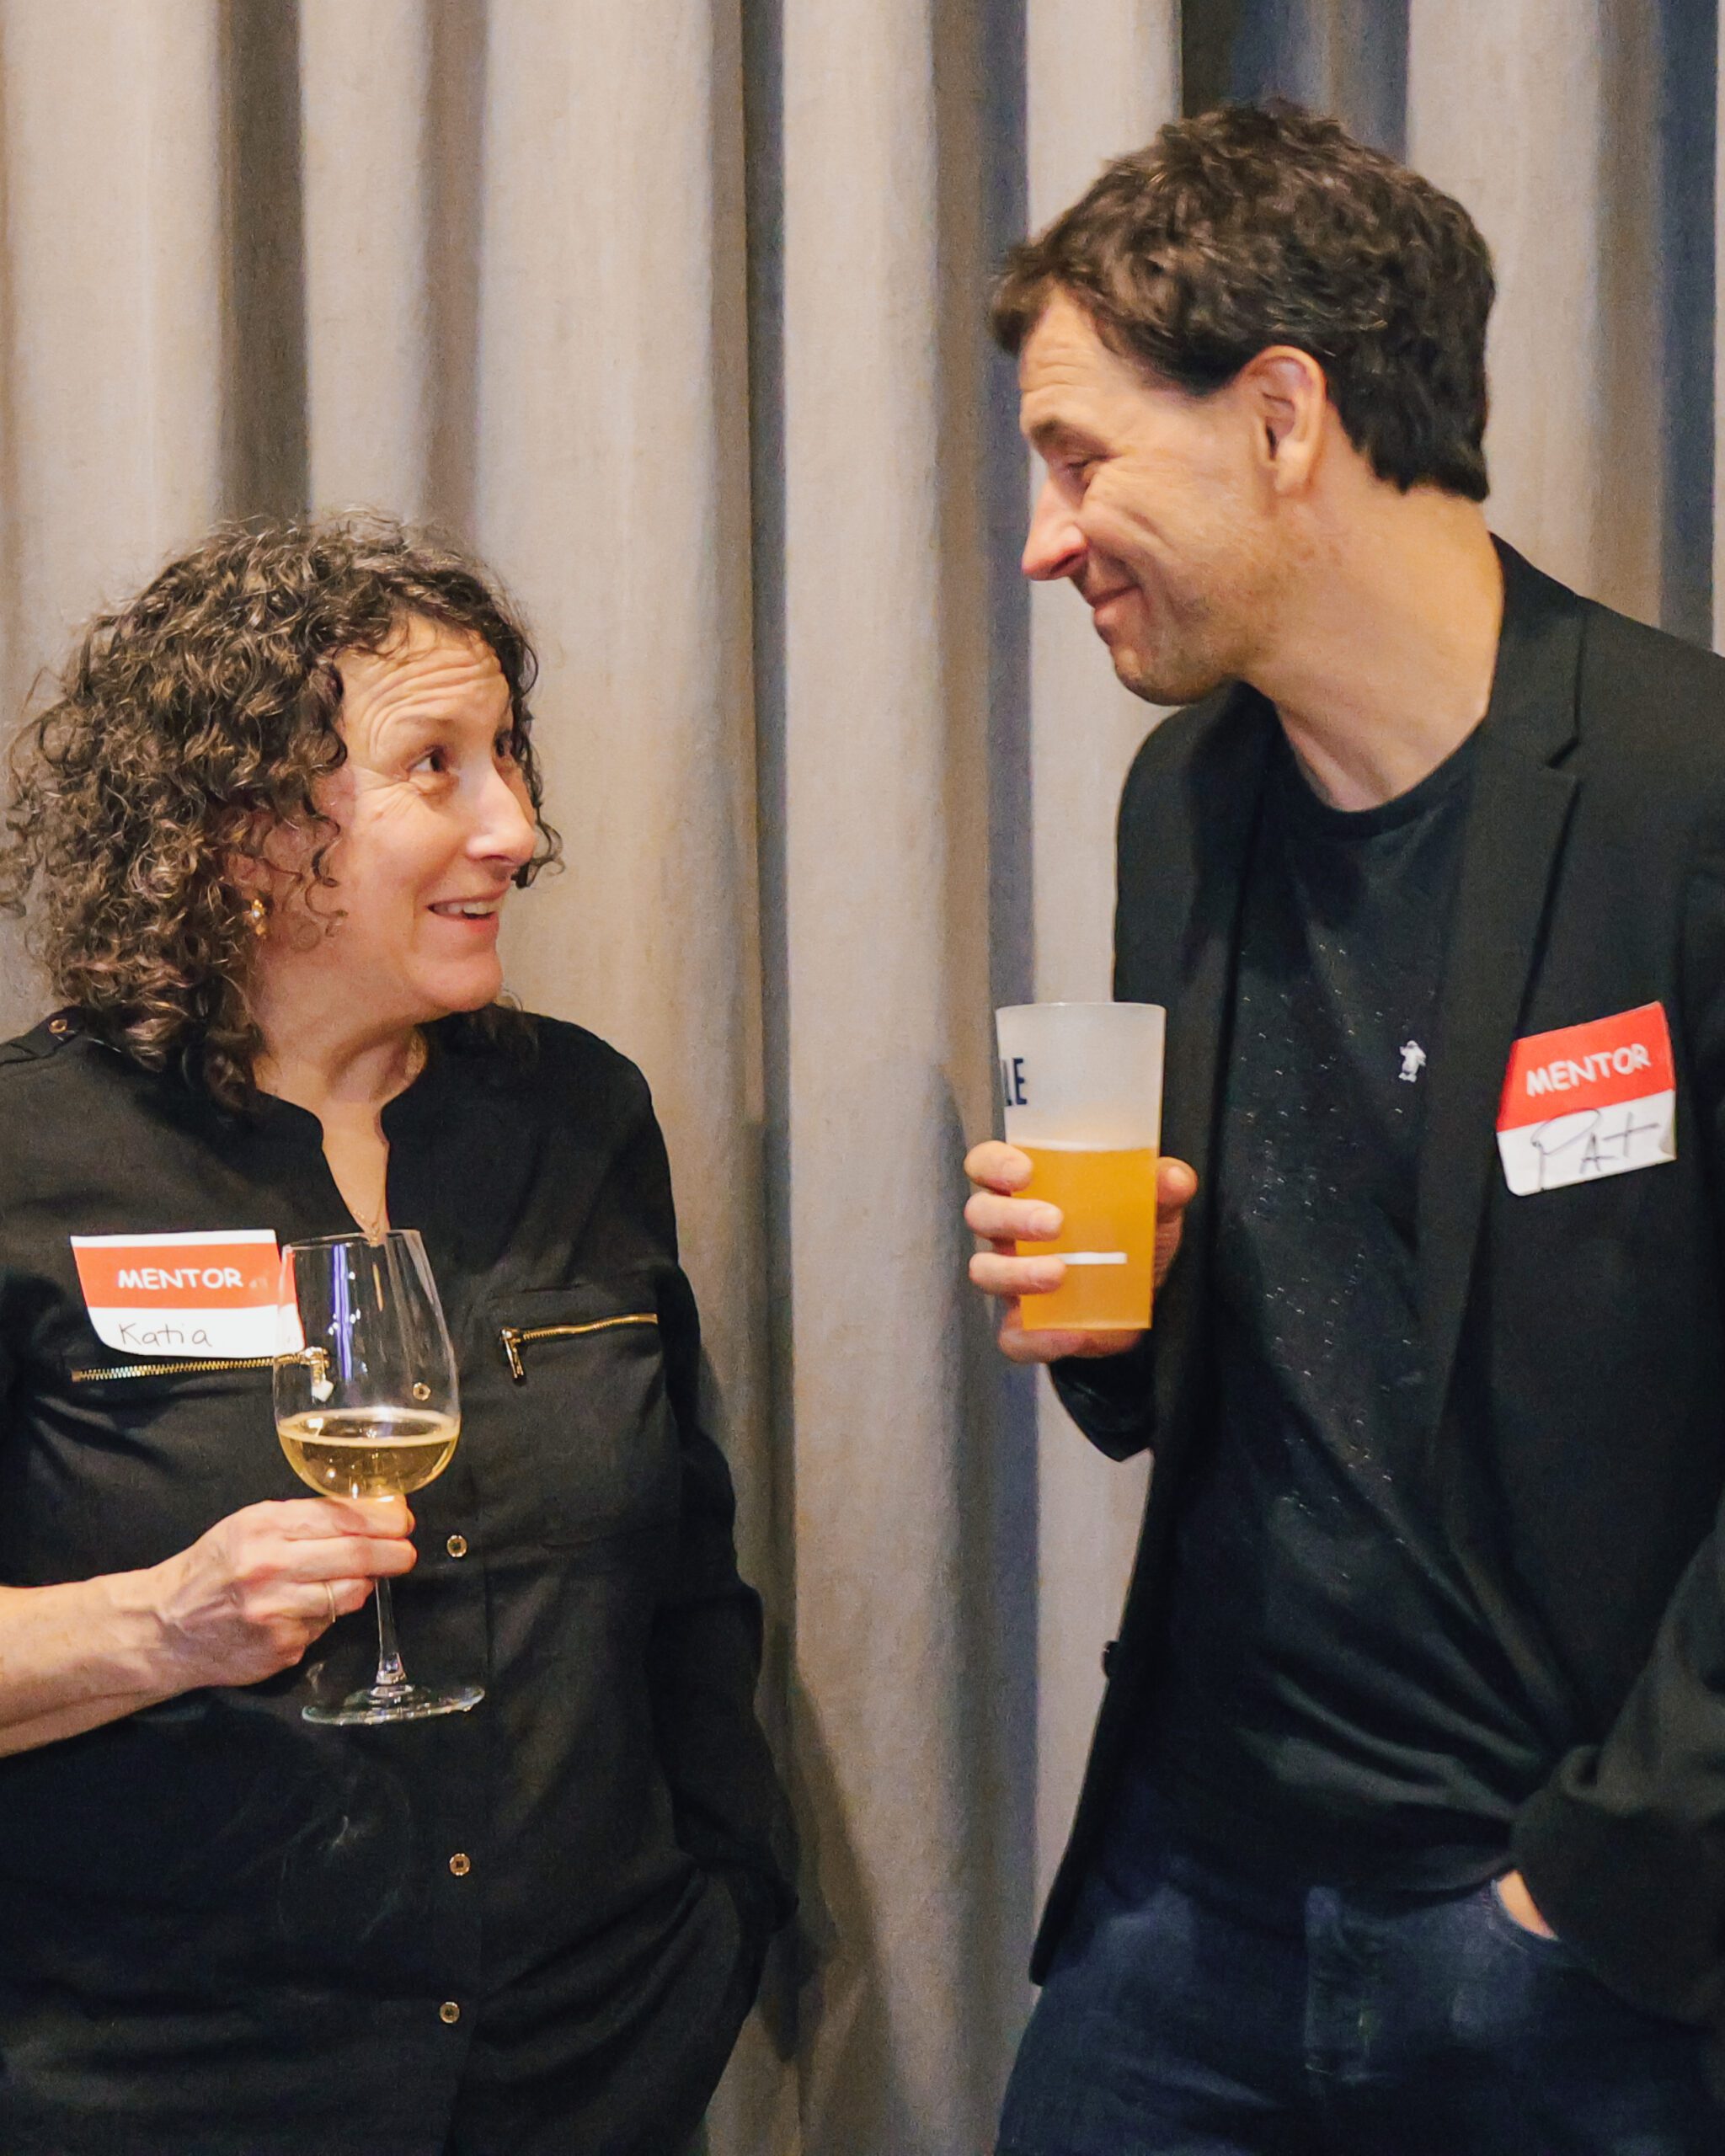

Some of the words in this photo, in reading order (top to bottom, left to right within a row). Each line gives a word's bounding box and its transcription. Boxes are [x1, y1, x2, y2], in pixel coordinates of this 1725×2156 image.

[1525, 1043, 1652, 1097] MENTOR
[117, 1267, 243, 1289] MENTOR
[118, 1323, 212, 1348] Katia
